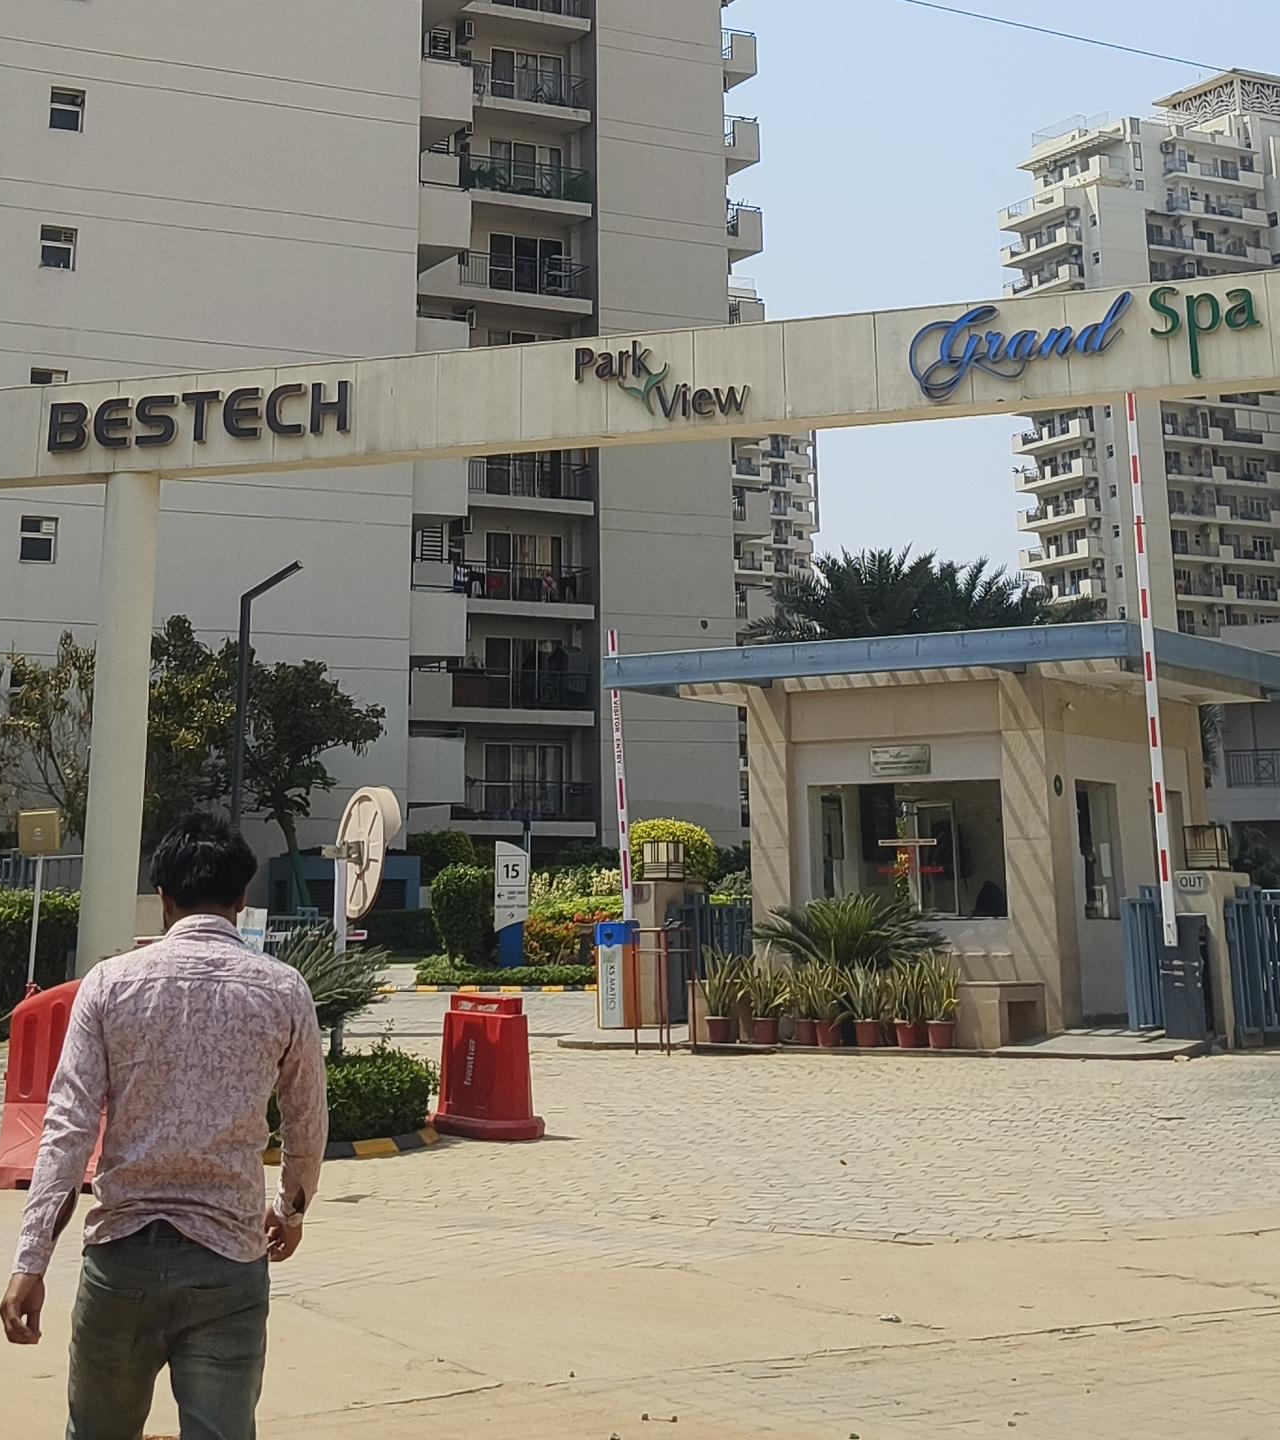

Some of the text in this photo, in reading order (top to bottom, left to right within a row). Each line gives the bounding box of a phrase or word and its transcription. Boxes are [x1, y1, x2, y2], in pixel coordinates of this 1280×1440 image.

[575, 340, 653, 383] Park
[909, 286, 1263, 401] Grand Spa
[47, 380, 352, 454] BESTECH
[655, 382, 751, 421] View
[503, 863, 520, 879] 15
[1180, 876, 1203, 888] OUT
